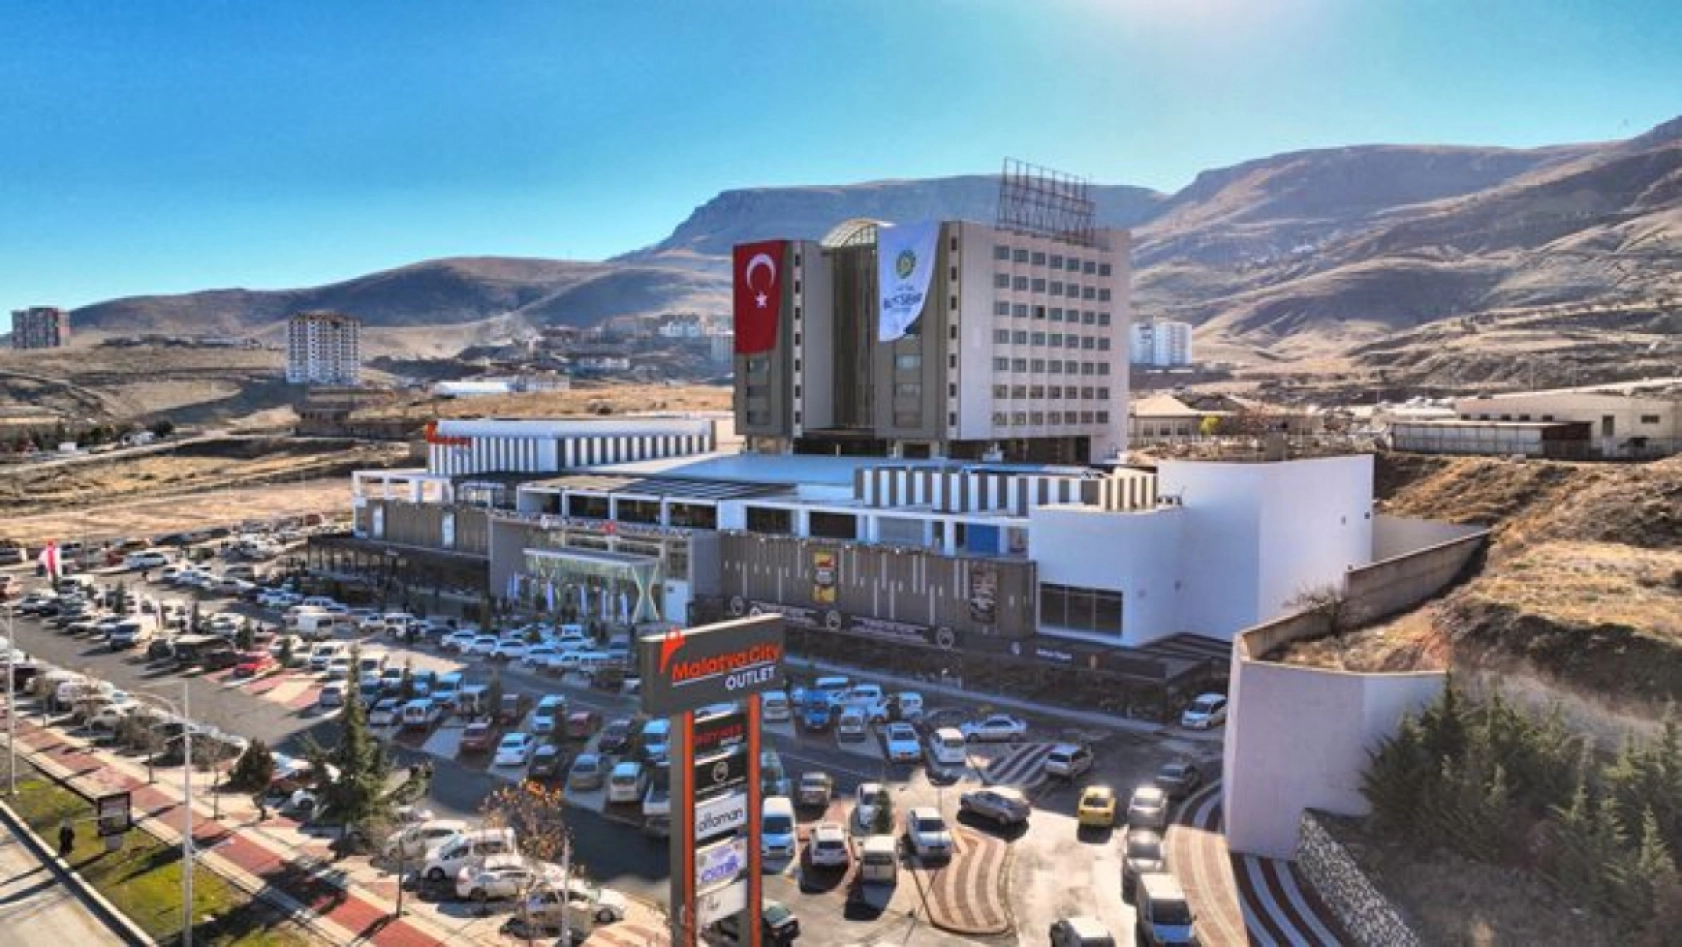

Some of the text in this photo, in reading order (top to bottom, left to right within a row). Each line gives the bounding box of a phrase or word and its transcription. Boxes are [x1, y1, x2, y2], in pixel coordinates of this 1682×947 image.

[672, 641, 781, 681] Malatya City
[724, 665, 776, 690] OUTLET
